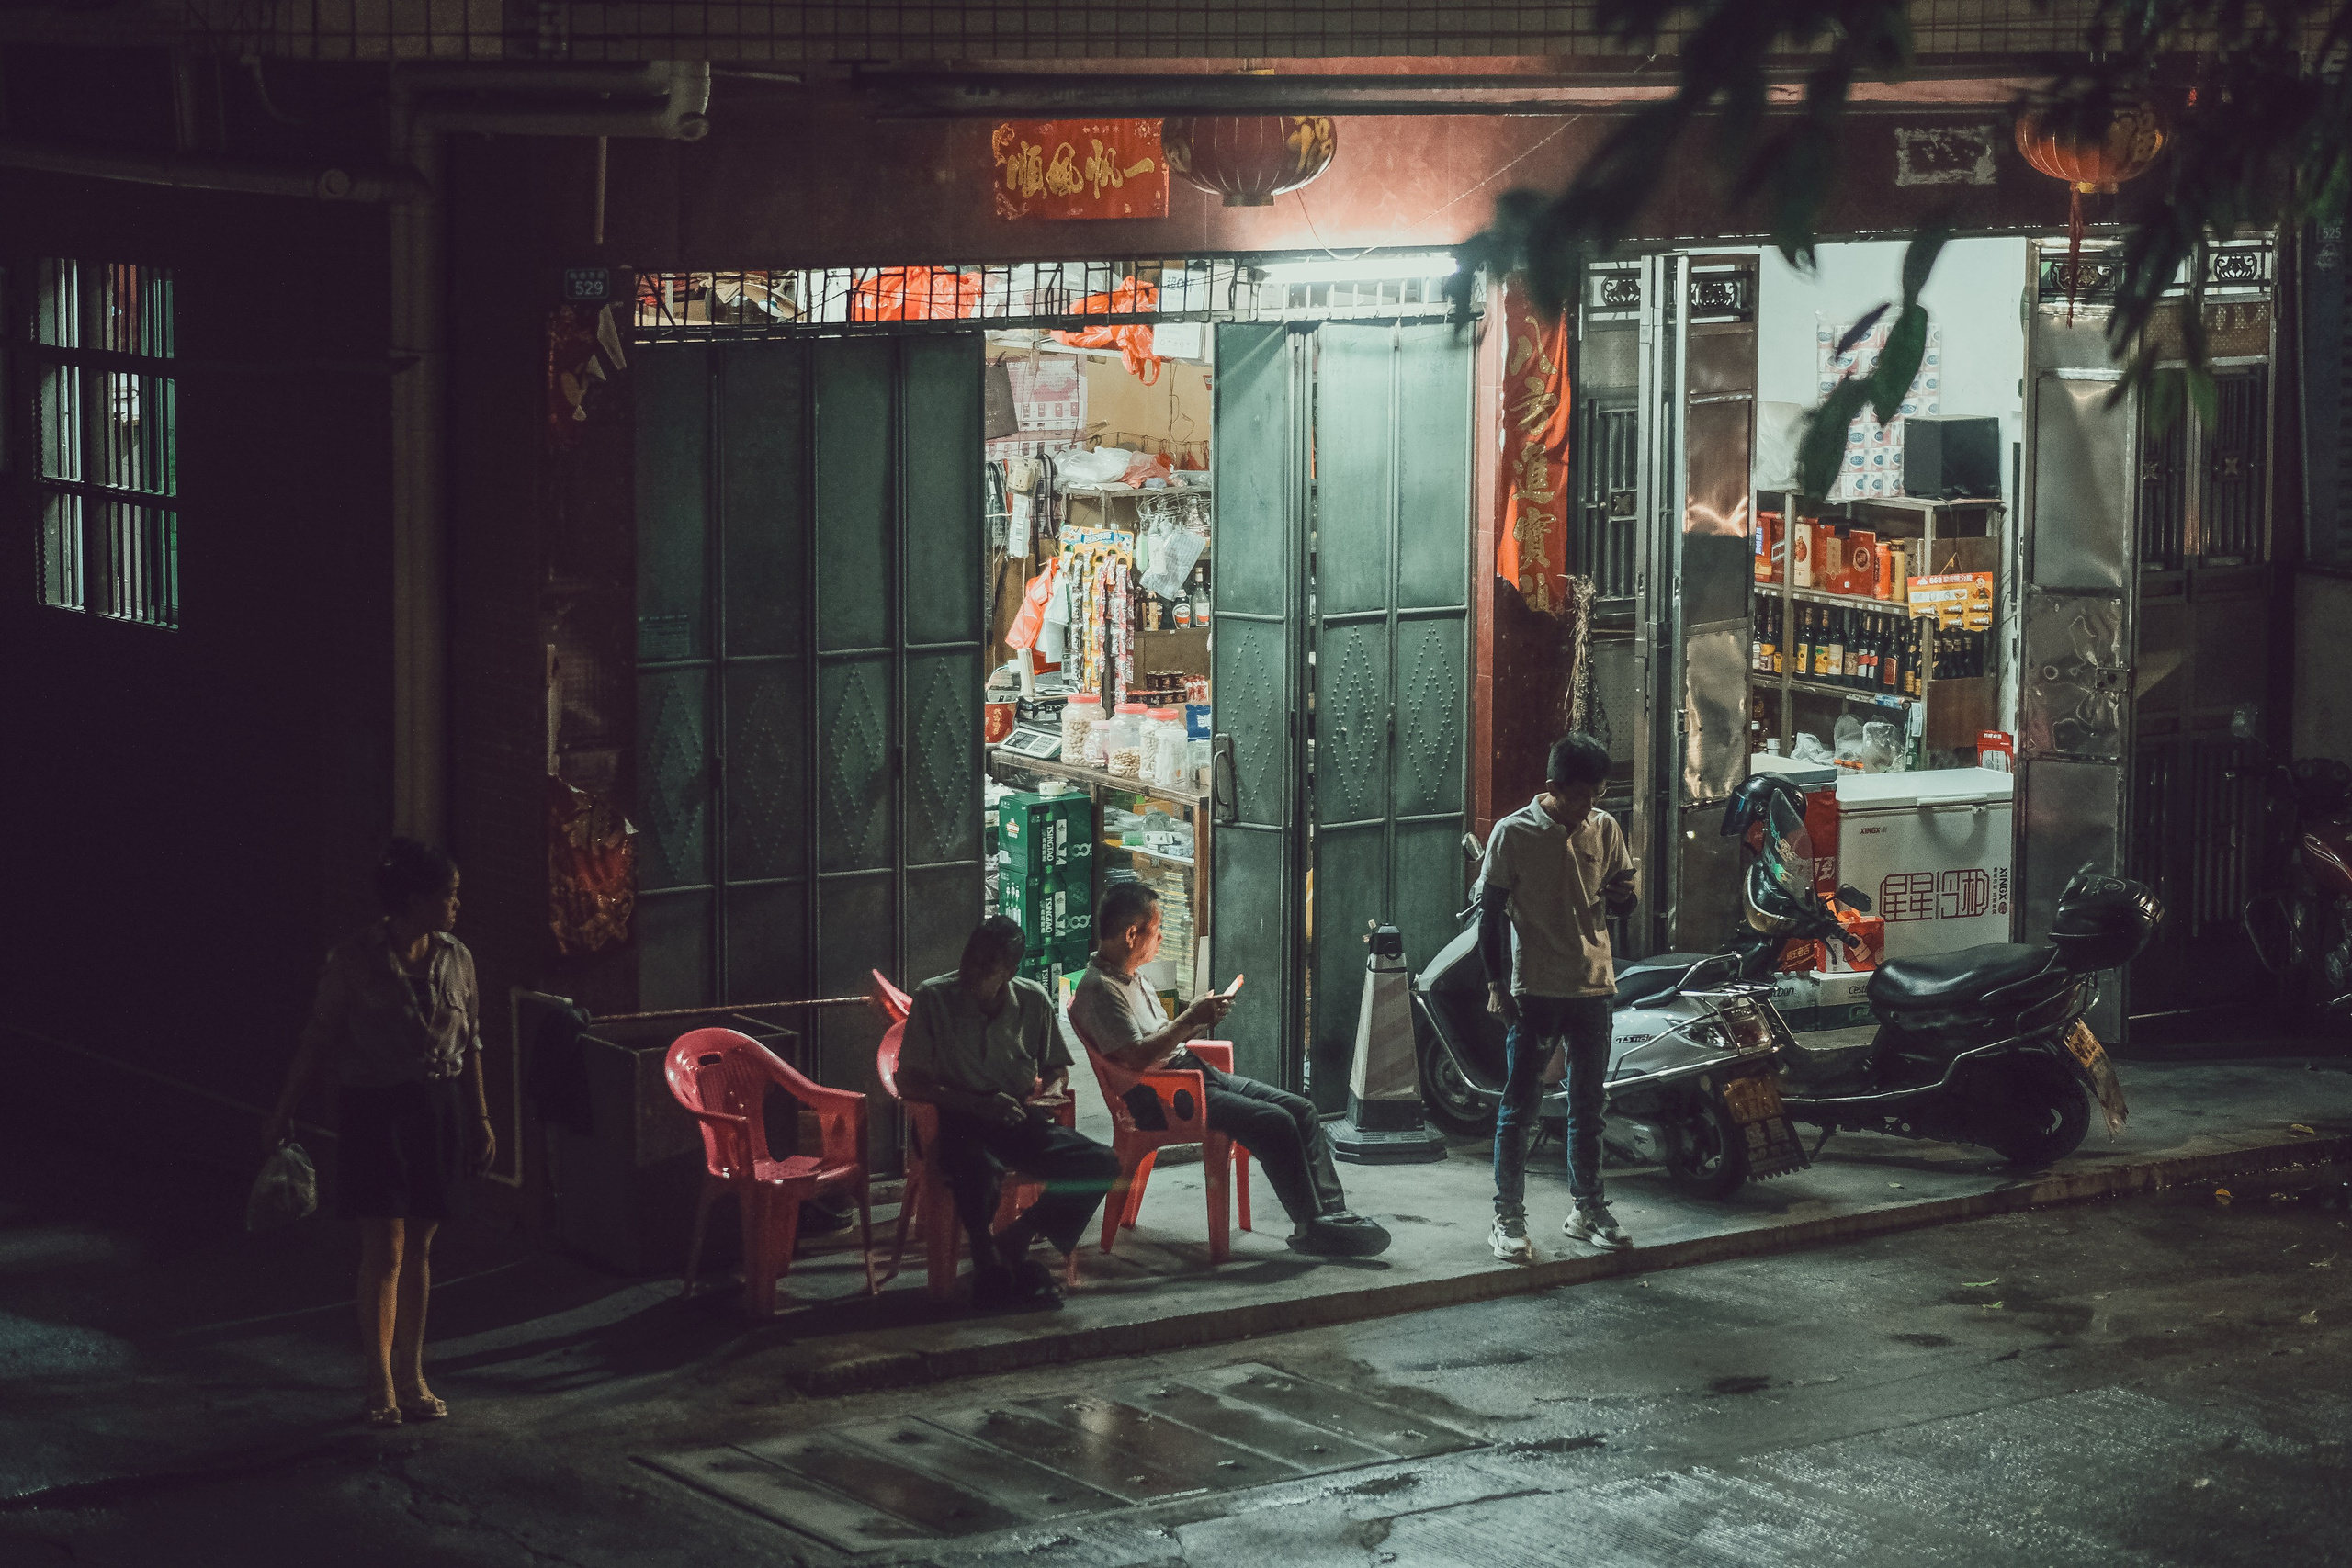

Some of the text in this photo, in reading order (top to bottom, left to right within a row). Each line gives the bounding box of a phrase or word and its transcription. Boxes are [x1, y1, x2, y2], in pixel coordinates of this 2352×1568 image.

[2323, 227, 2342, 239] 525
[574, 280, 604, 296] 529
[1860, 827, 1880, 835] XINGX
[1999, 867, 2007, 900] XINGX
[1045, 897, 1053, 933] TSINGTAO
